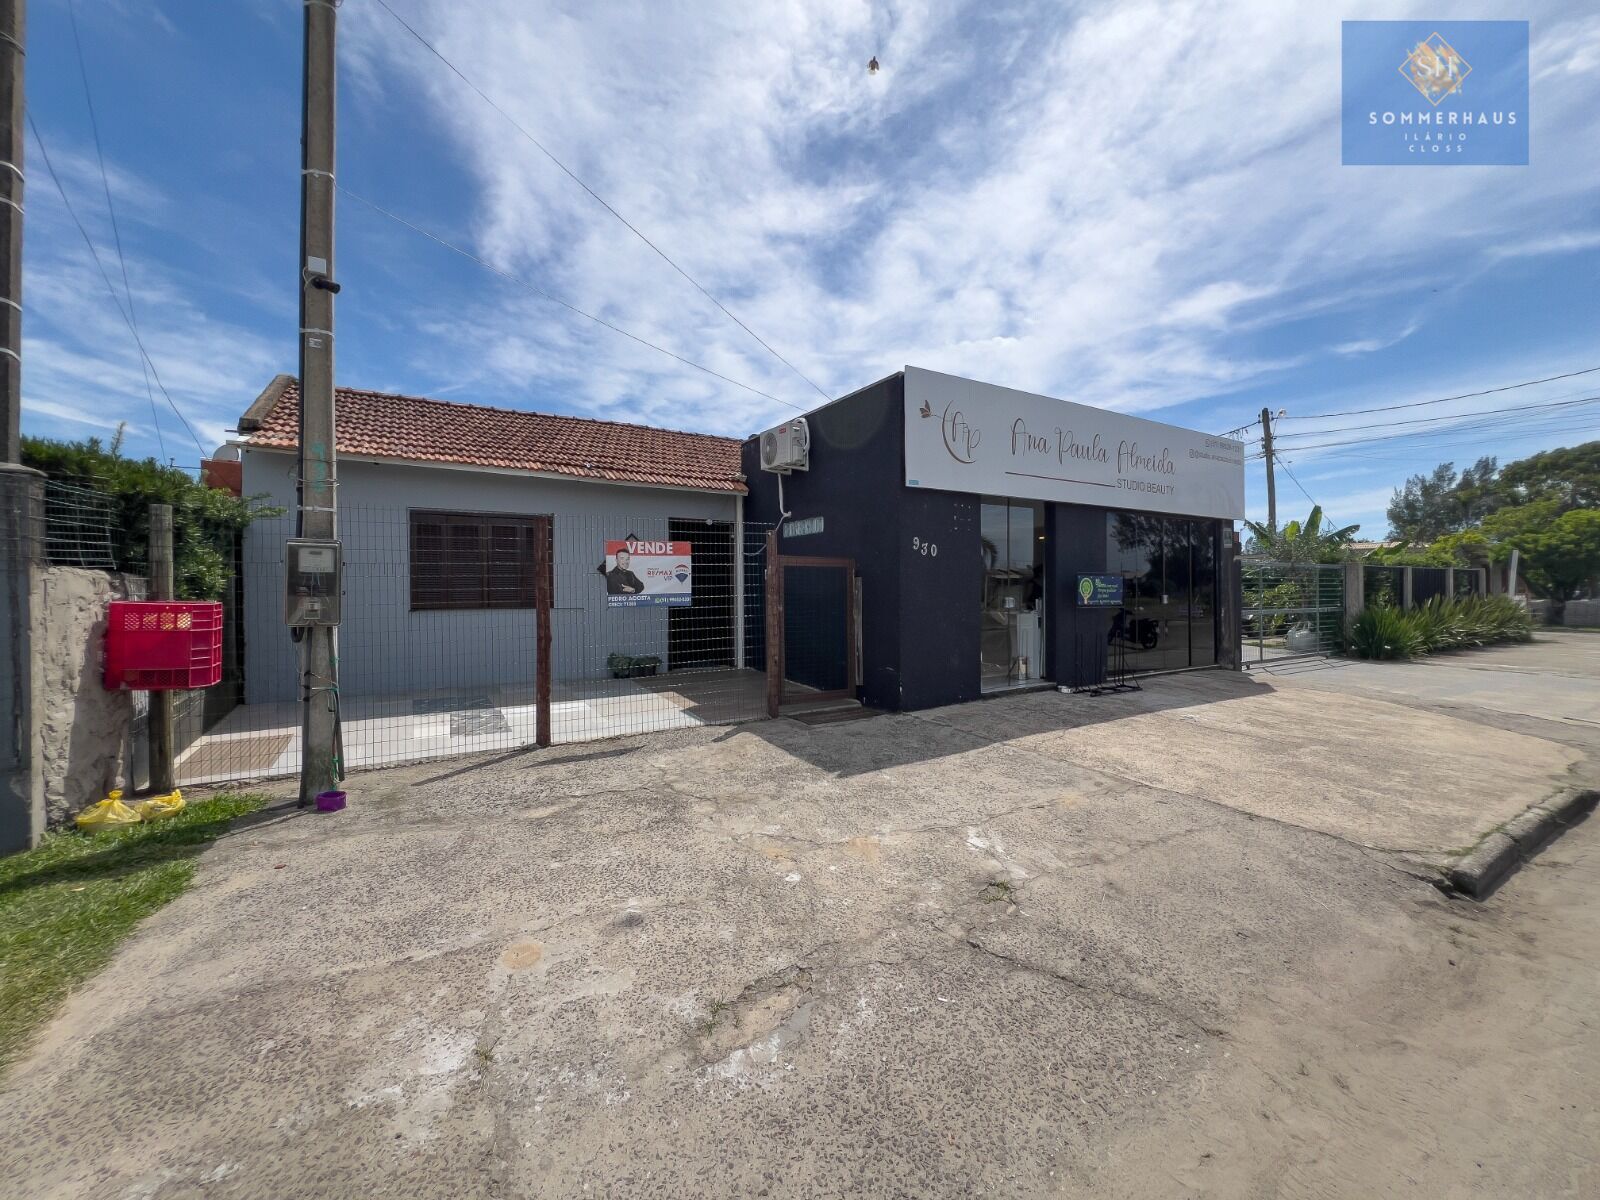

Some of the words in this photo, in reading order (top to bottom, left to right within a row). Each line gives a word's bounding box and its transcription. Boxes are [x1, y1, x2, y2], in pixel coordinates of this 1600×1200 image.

[1010, 417, 1052, 457] Ana
[1055, 426, 1111, 465] Paula
[1117, 440, 1176, 475] Almeida
[1116, 478, 1145, 493] STUDIO
[1146, 483, 1175, 496] BEAUTY
[626, 541, 673, 554] VENDE
[912, 536, 938, 557] 930
